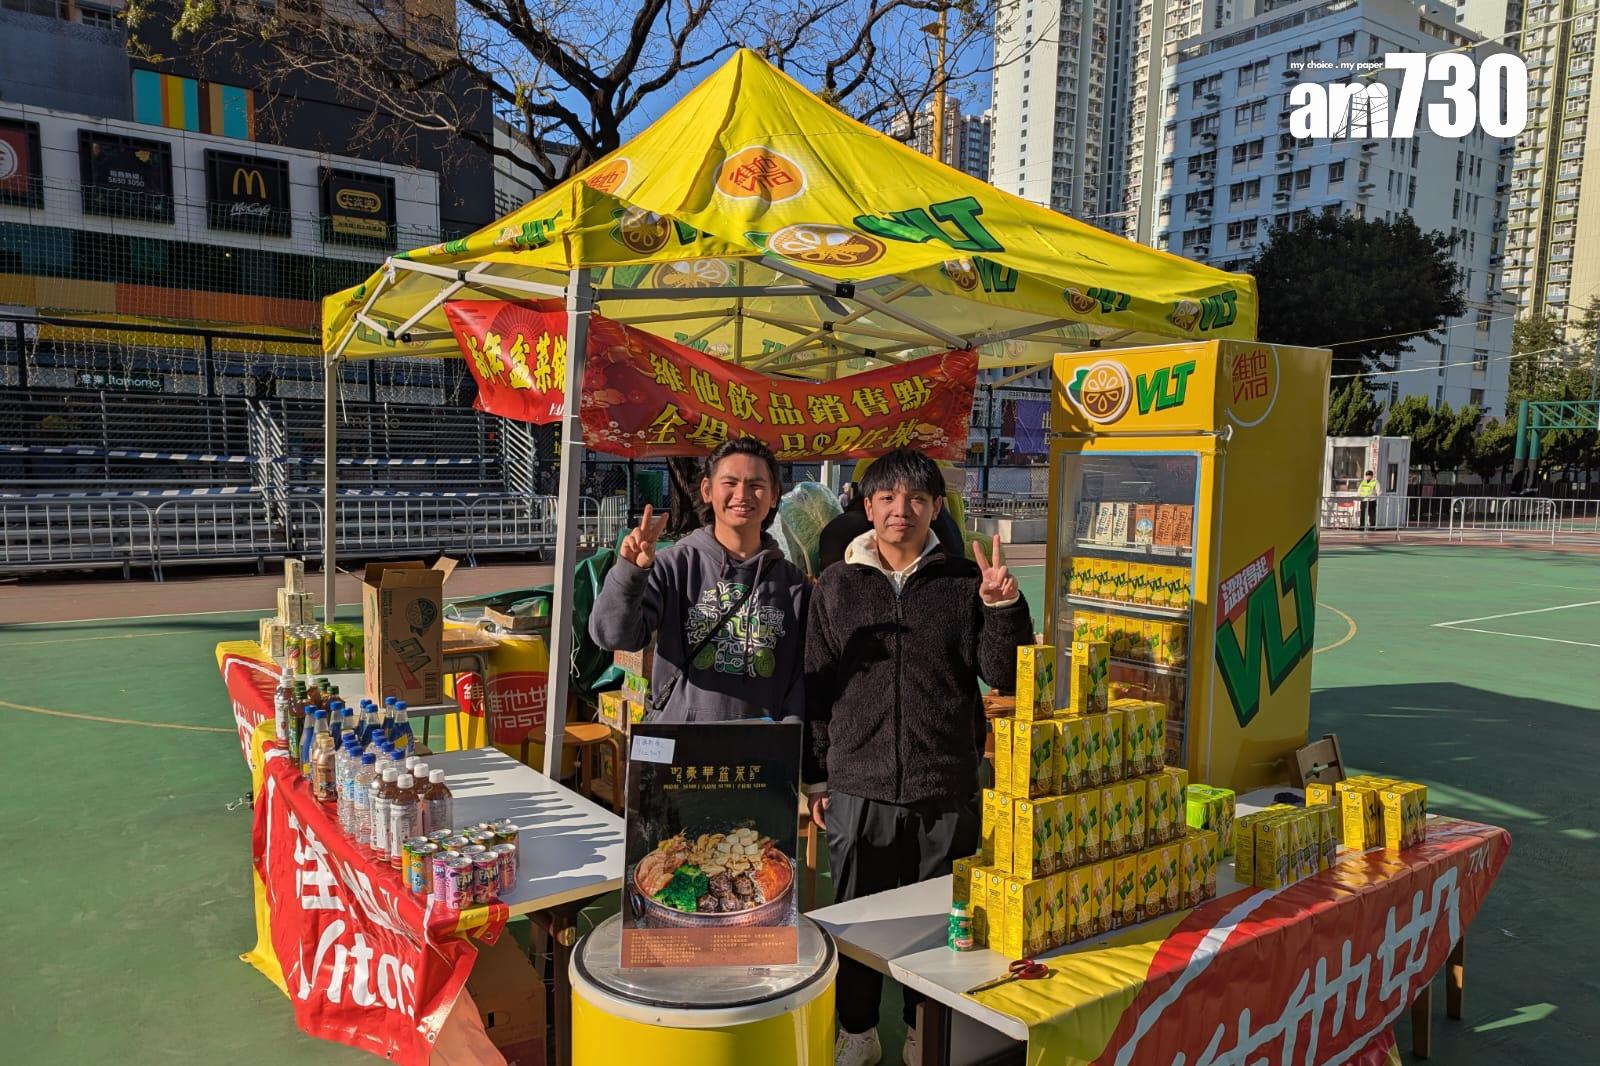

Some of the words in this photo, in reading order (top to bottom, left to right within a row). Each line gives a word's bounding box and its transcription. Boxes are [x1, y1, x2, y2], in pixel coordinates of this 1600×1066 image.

[853, 196, 1006, 253] VLT
[1199, 290, 1238, 331] VLT
[649, 354, 936, 426] 維他飲品銷售點
[1136, 360, 1196, 416] VLT
[1215, 523, 1319, 729] VLT
